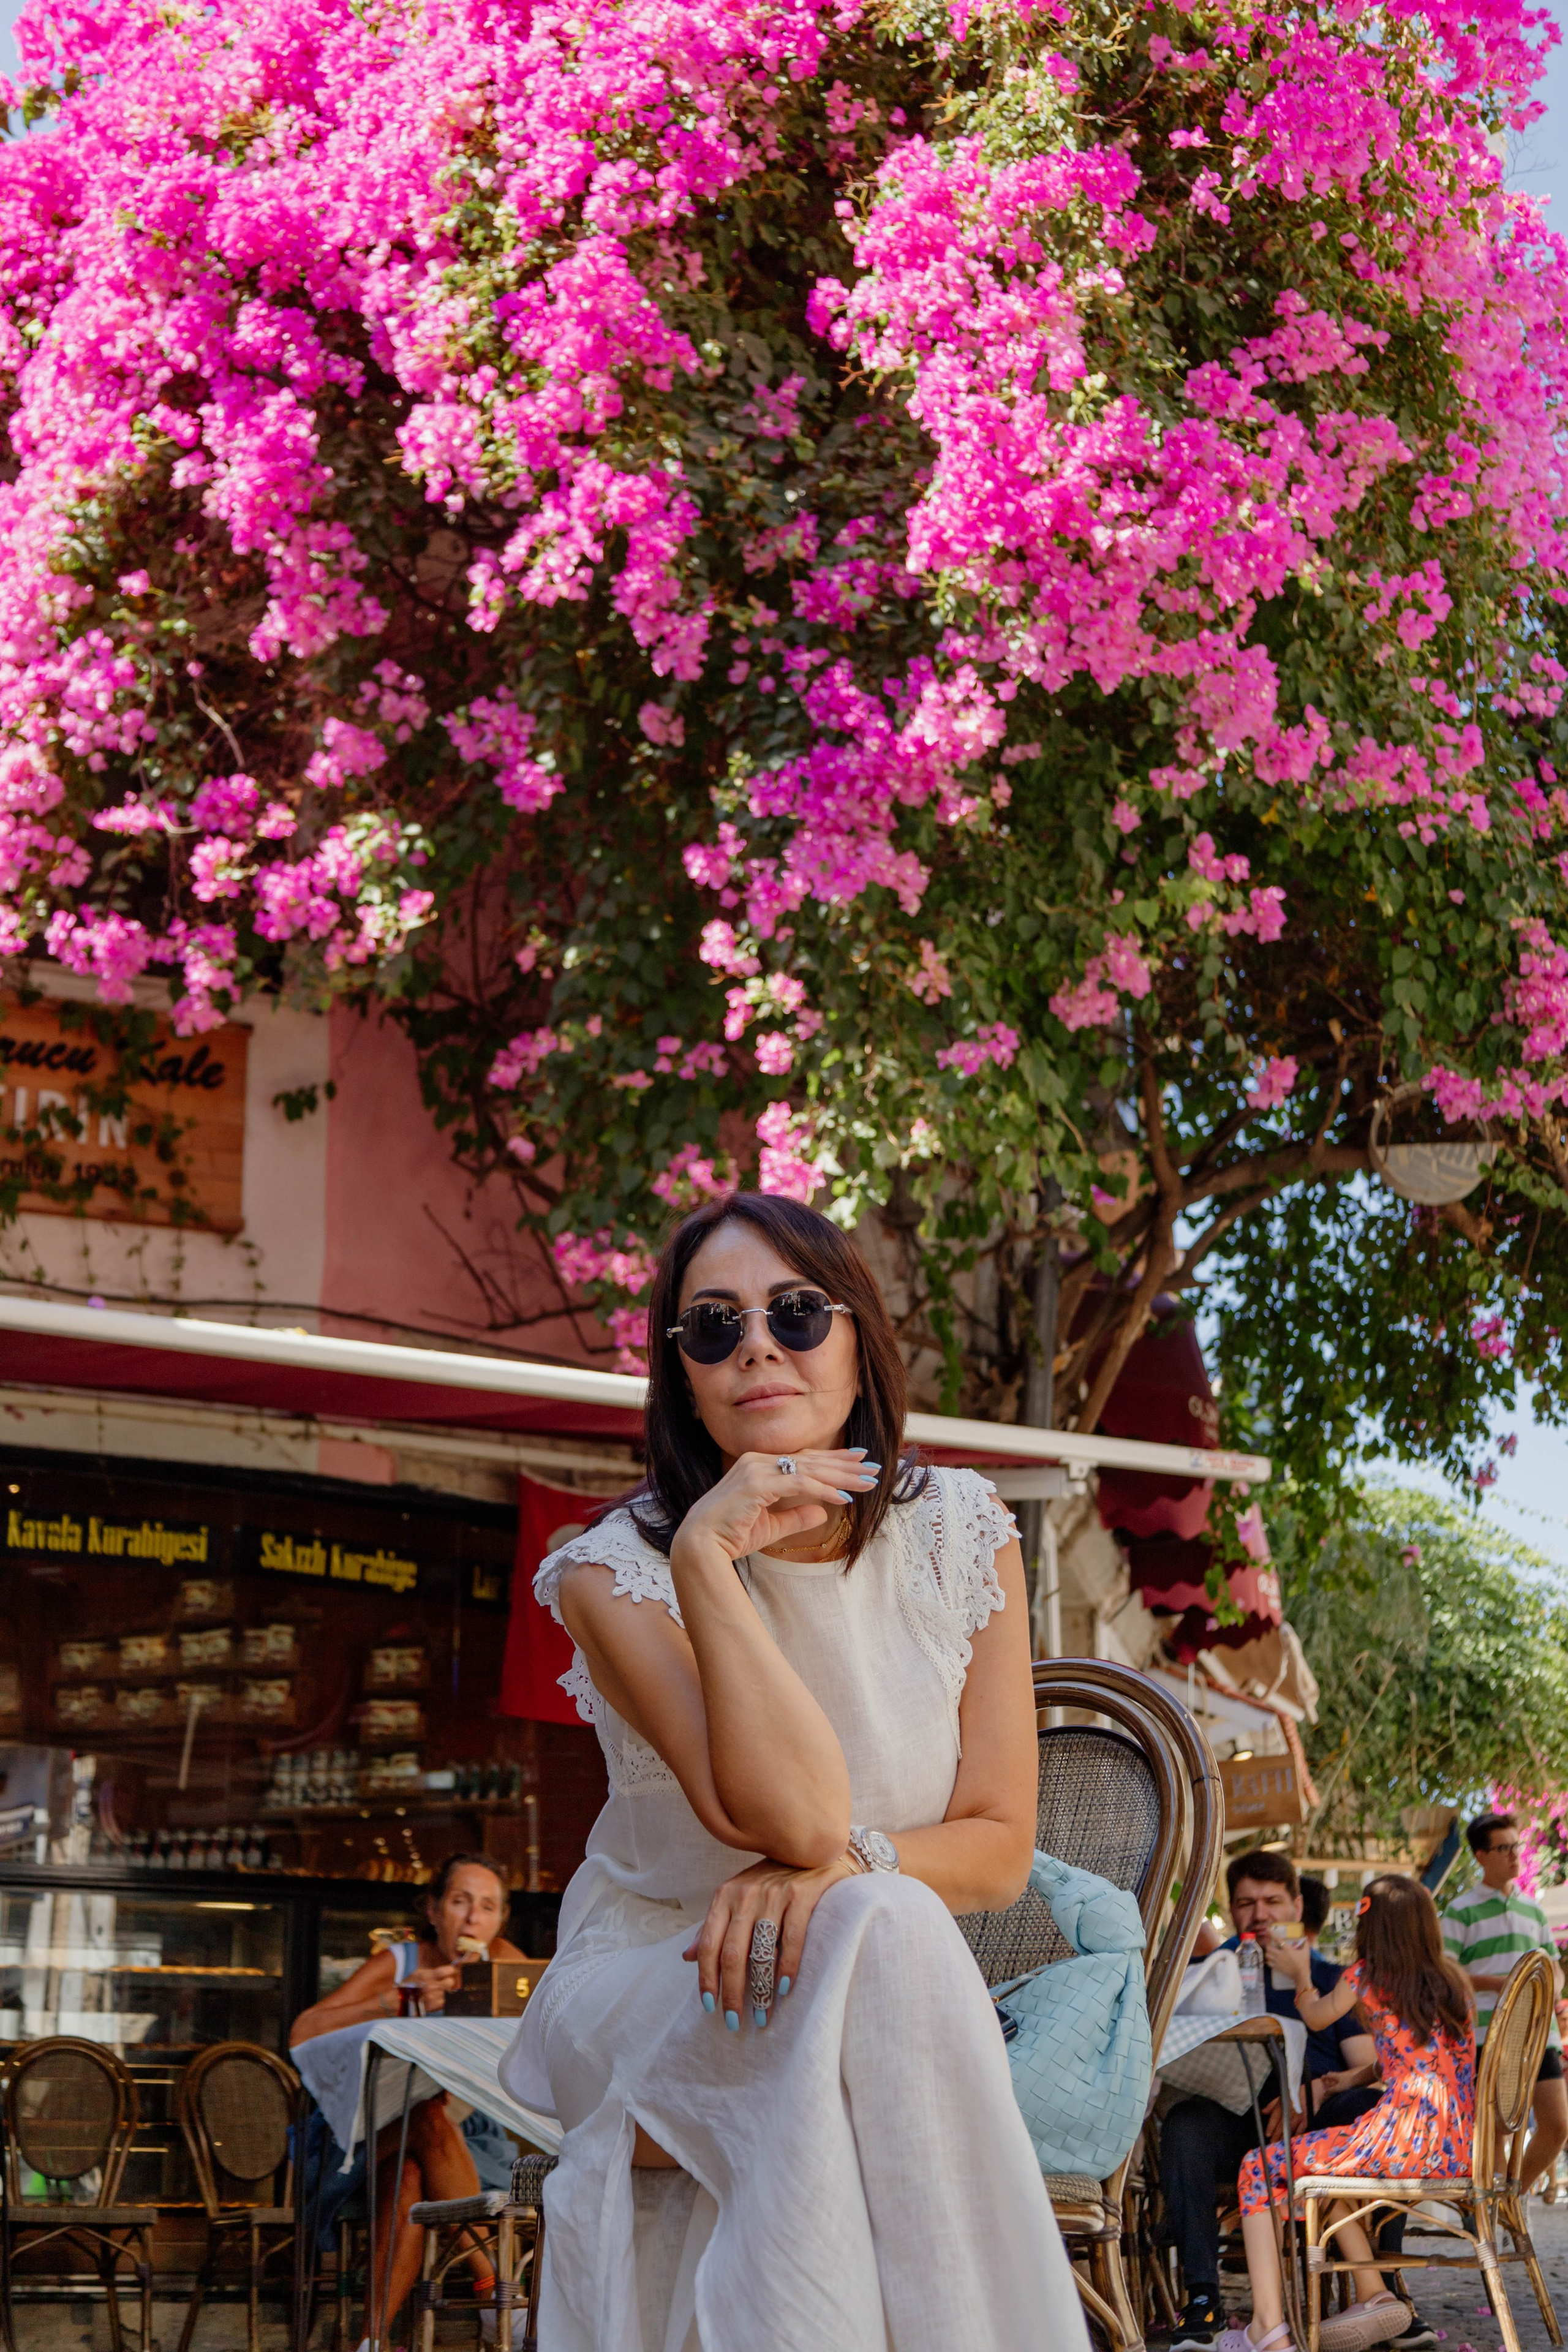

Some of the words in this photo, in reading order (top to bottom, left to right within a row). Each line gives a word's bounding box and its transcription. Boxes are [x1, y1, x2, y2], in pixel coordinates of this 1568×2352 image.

[0, 1084, 129, 1150] IRIN
[7, 1509, 82, 1553] Kavala
[88, 1516, 208, 1567] Kurabiyesi
[516, 1977, 530, 1998] 5
